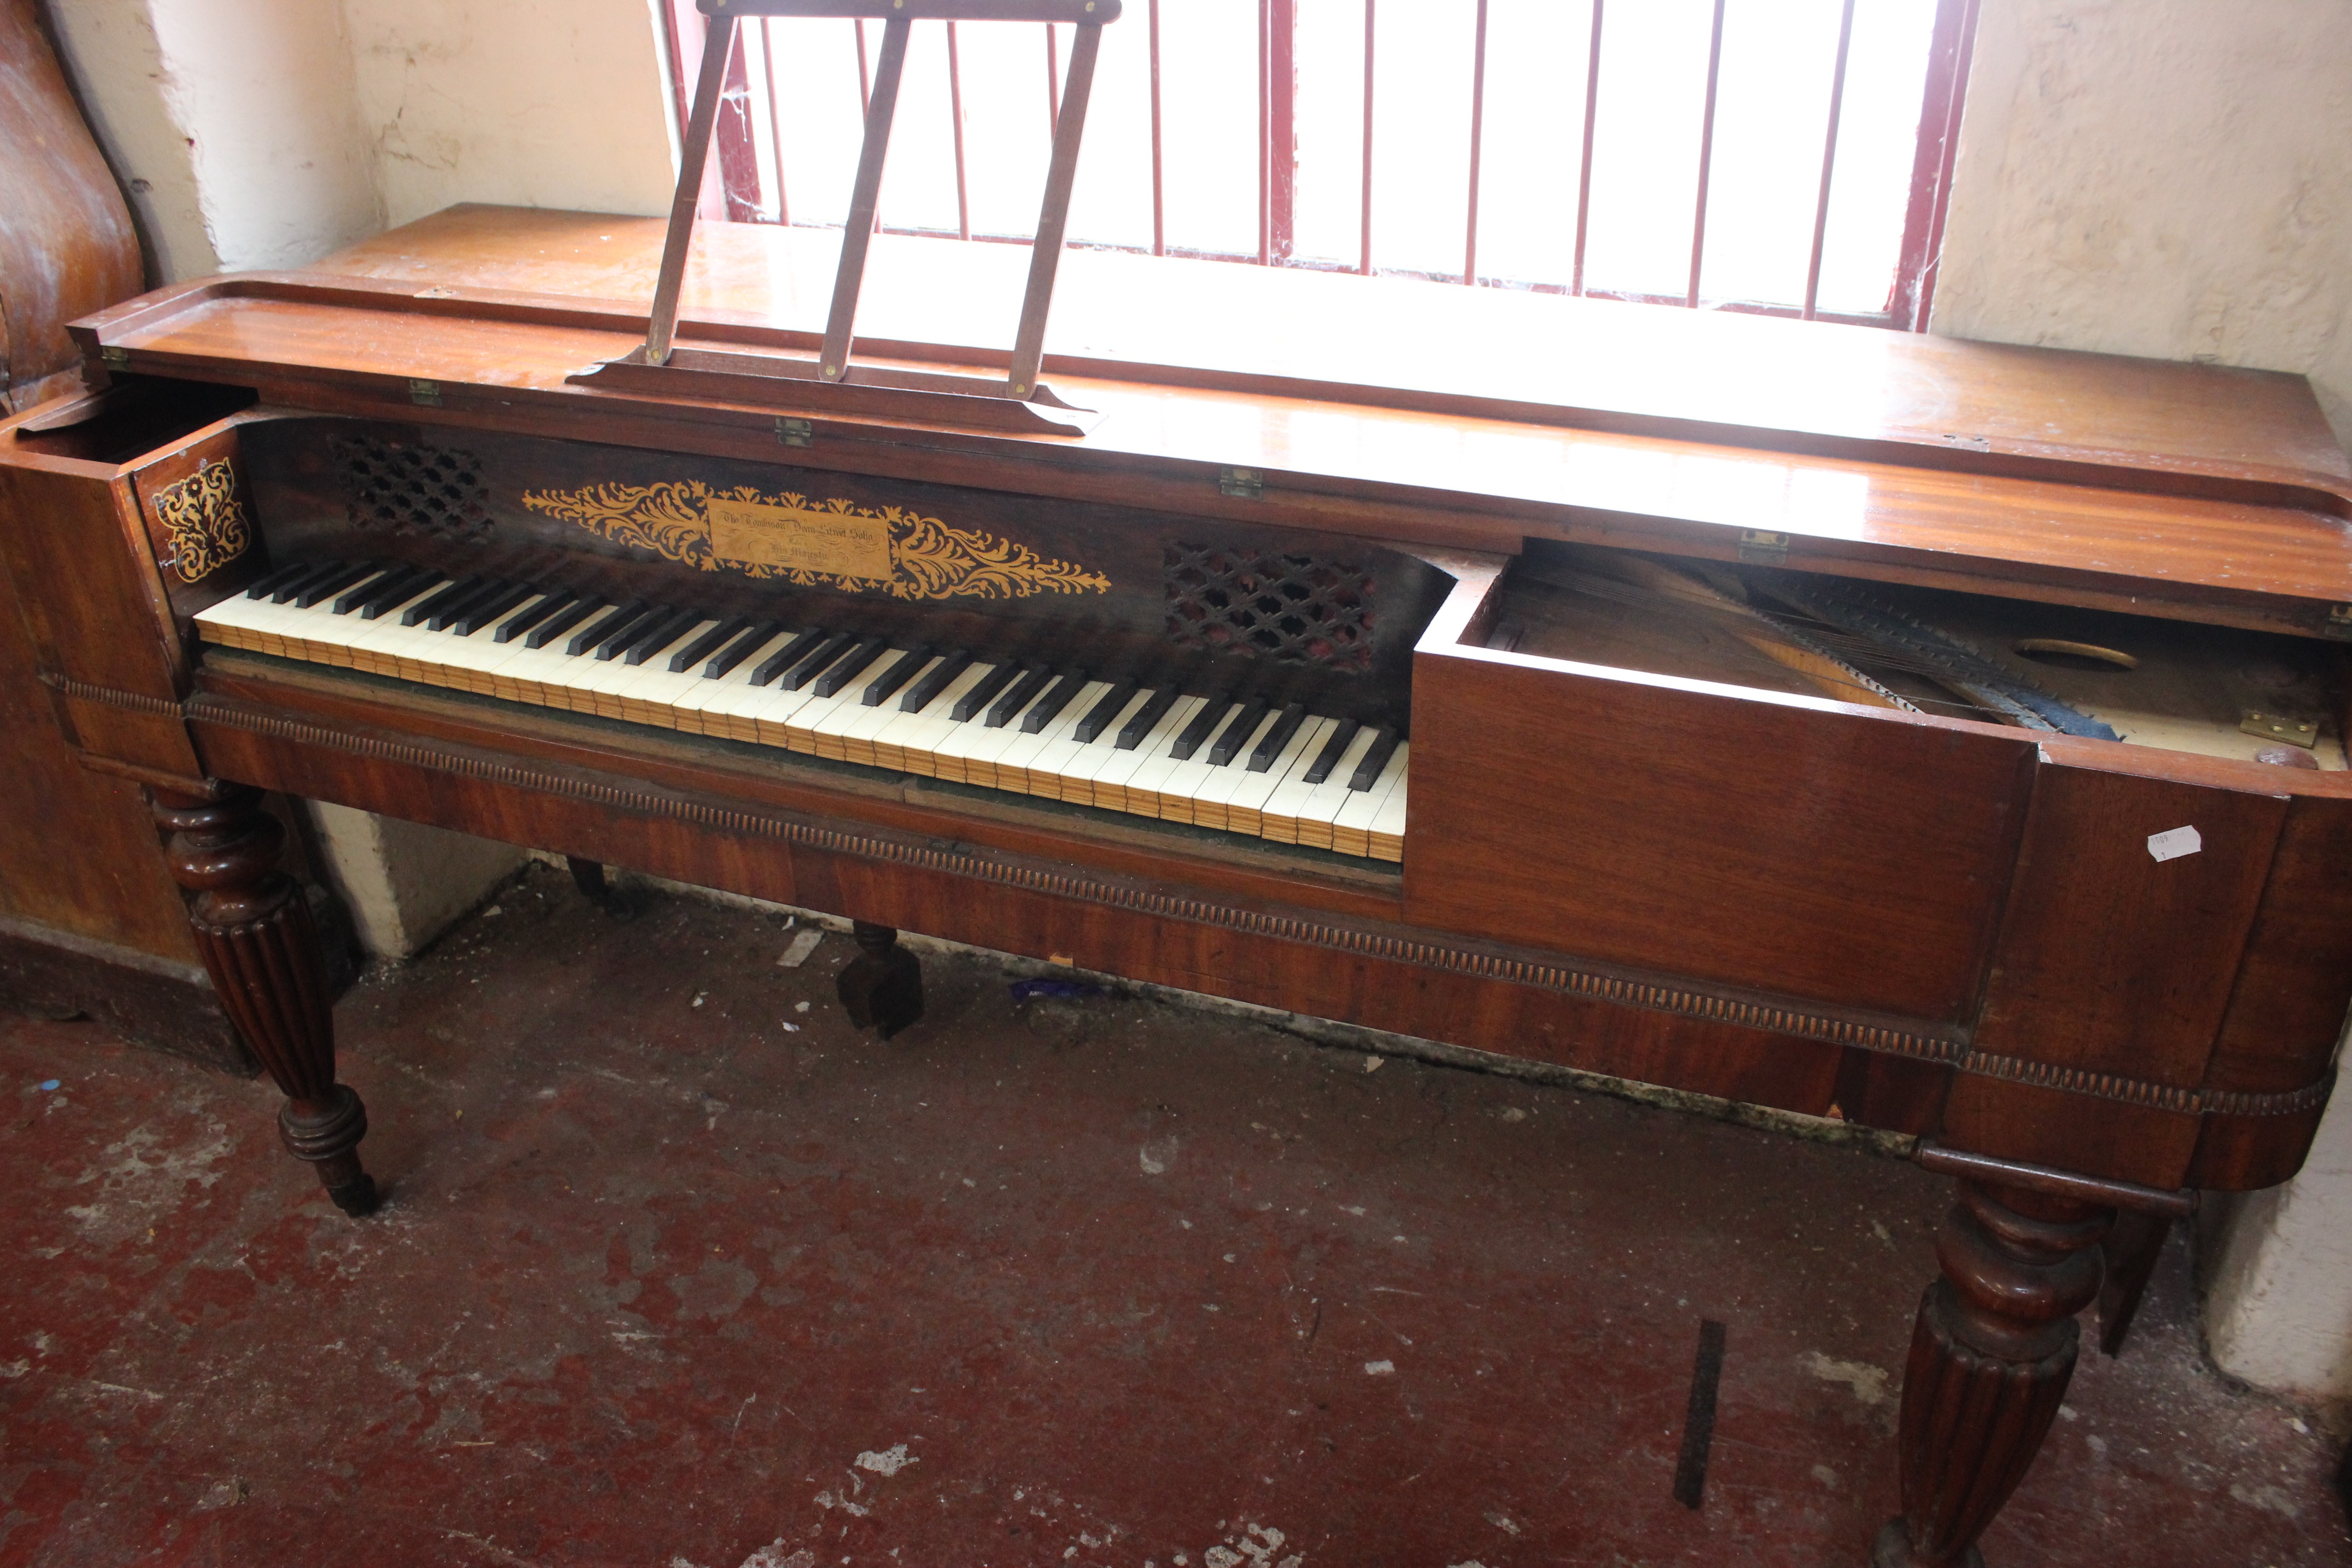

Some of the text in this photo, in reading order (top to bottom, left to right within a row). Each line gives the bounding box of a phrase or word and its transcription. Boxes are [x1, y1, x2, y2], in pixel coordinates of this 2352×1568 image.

[782, 518, 815, 534] Dean
[819, 524, 846, 537] Street
[850, 527, 872, 541] Soho
